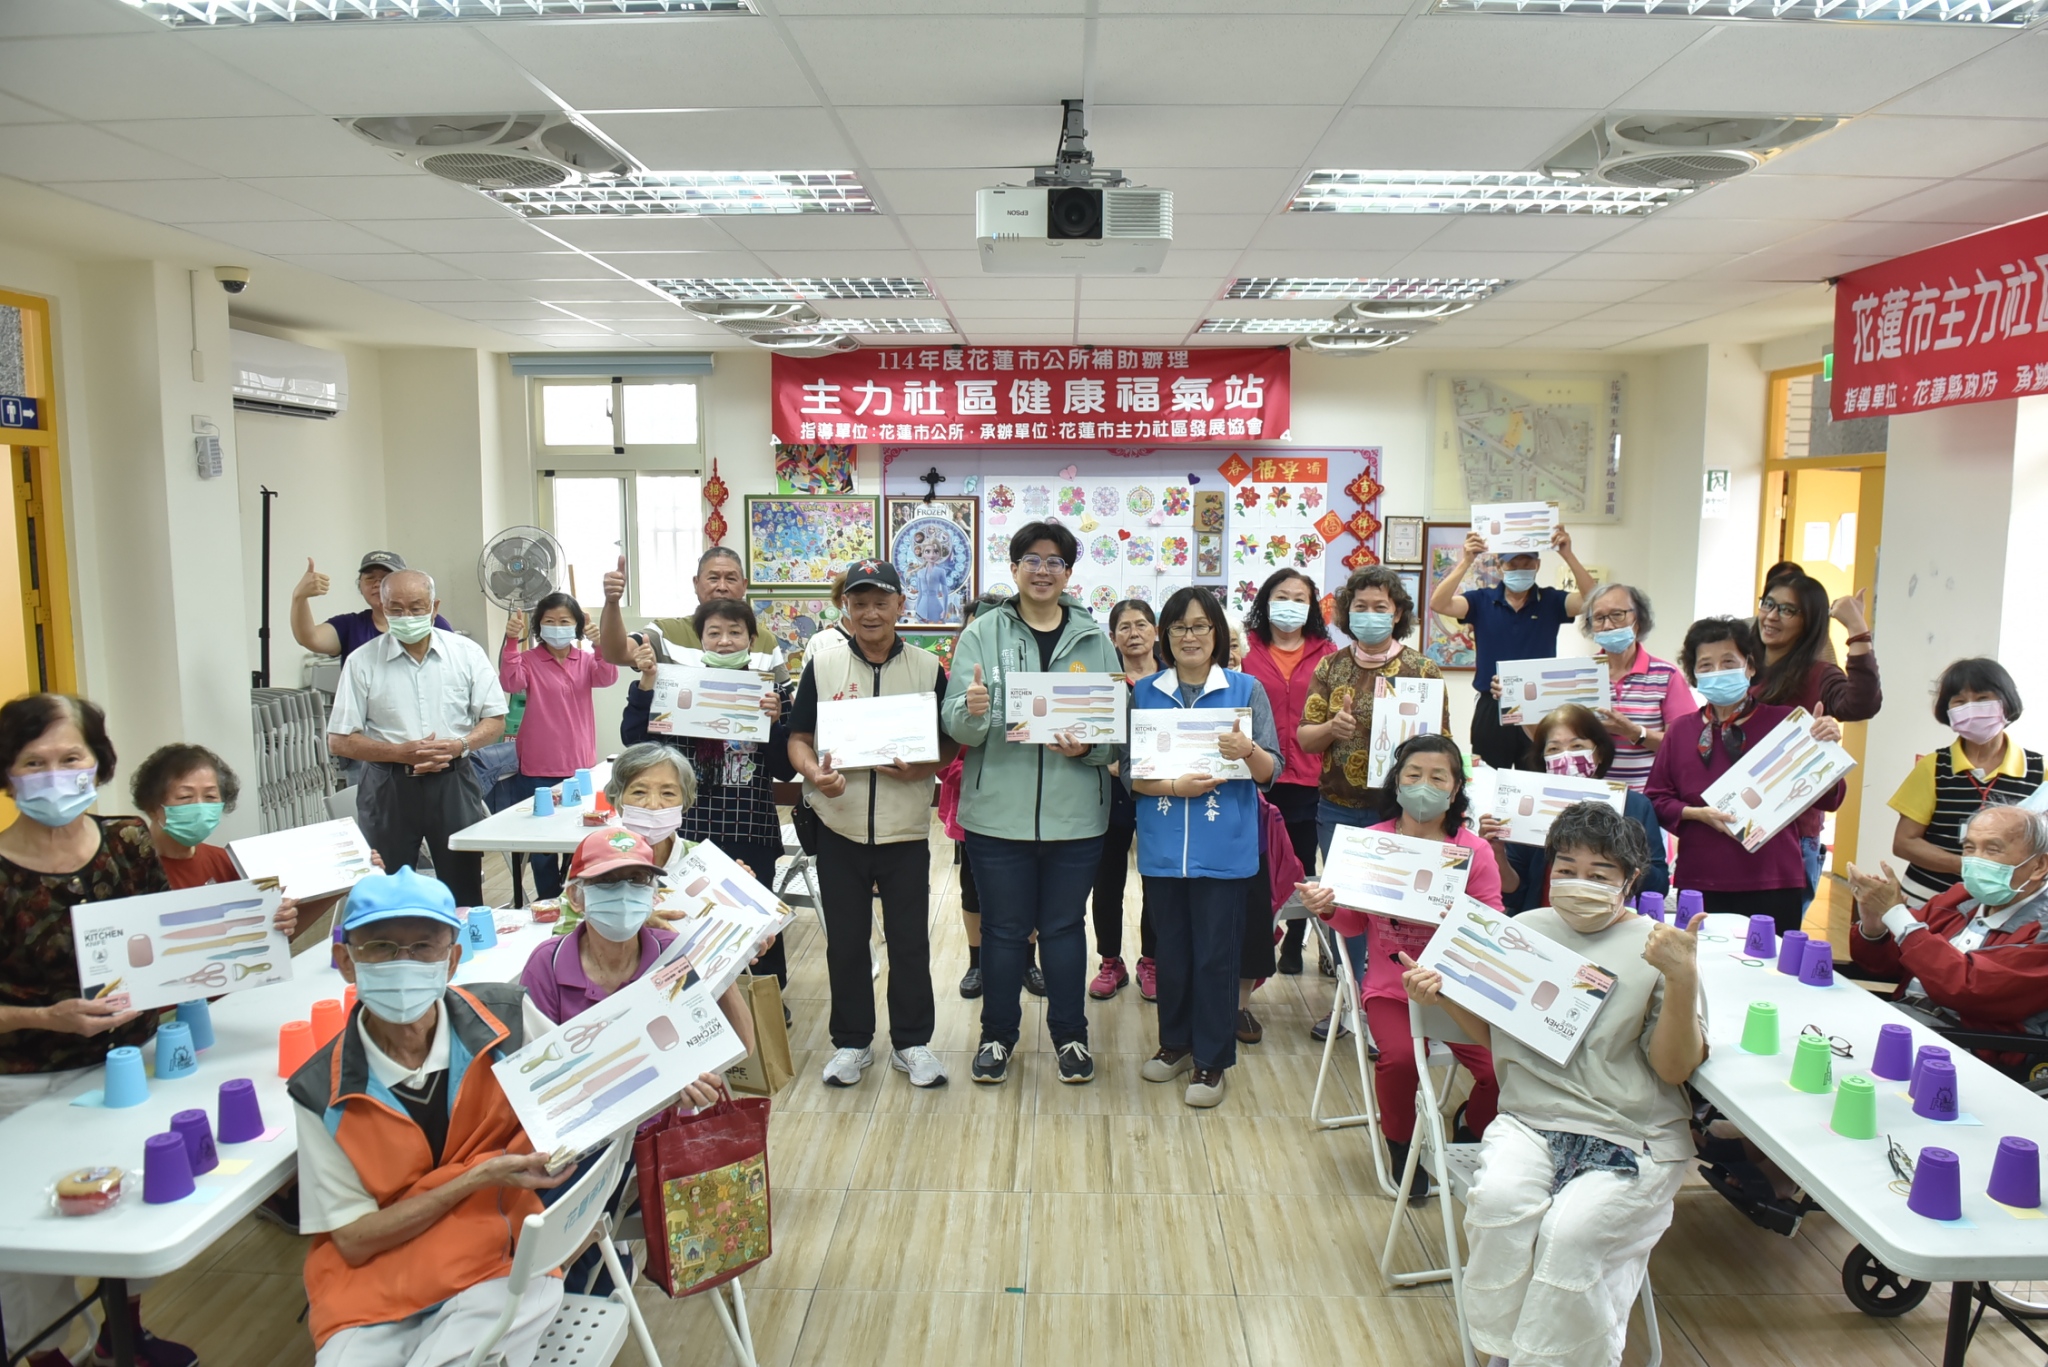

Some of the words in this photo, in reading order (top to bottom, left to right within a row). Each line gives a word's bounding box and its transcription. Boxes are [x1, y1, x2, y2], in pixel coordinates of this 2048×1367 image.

[878, 348, 1190, 371] 114年度花蓮市公所補助辦理
[800, 373, 1265, 416] 主力社區健康福氣站
[1157, 796, 1172, 816] 玲
[84, 929, 124, 942] KITCHEN
[85, 940, 106, 948] KNIFE
[699, 1016, 718, 1031] KNIFE
[1544, 1016, 1575, 1038] KITCHEN
[1561, 1019, 1578, 1031] KNIFE
[686, 1021, 722, 1047] KITCHEN
